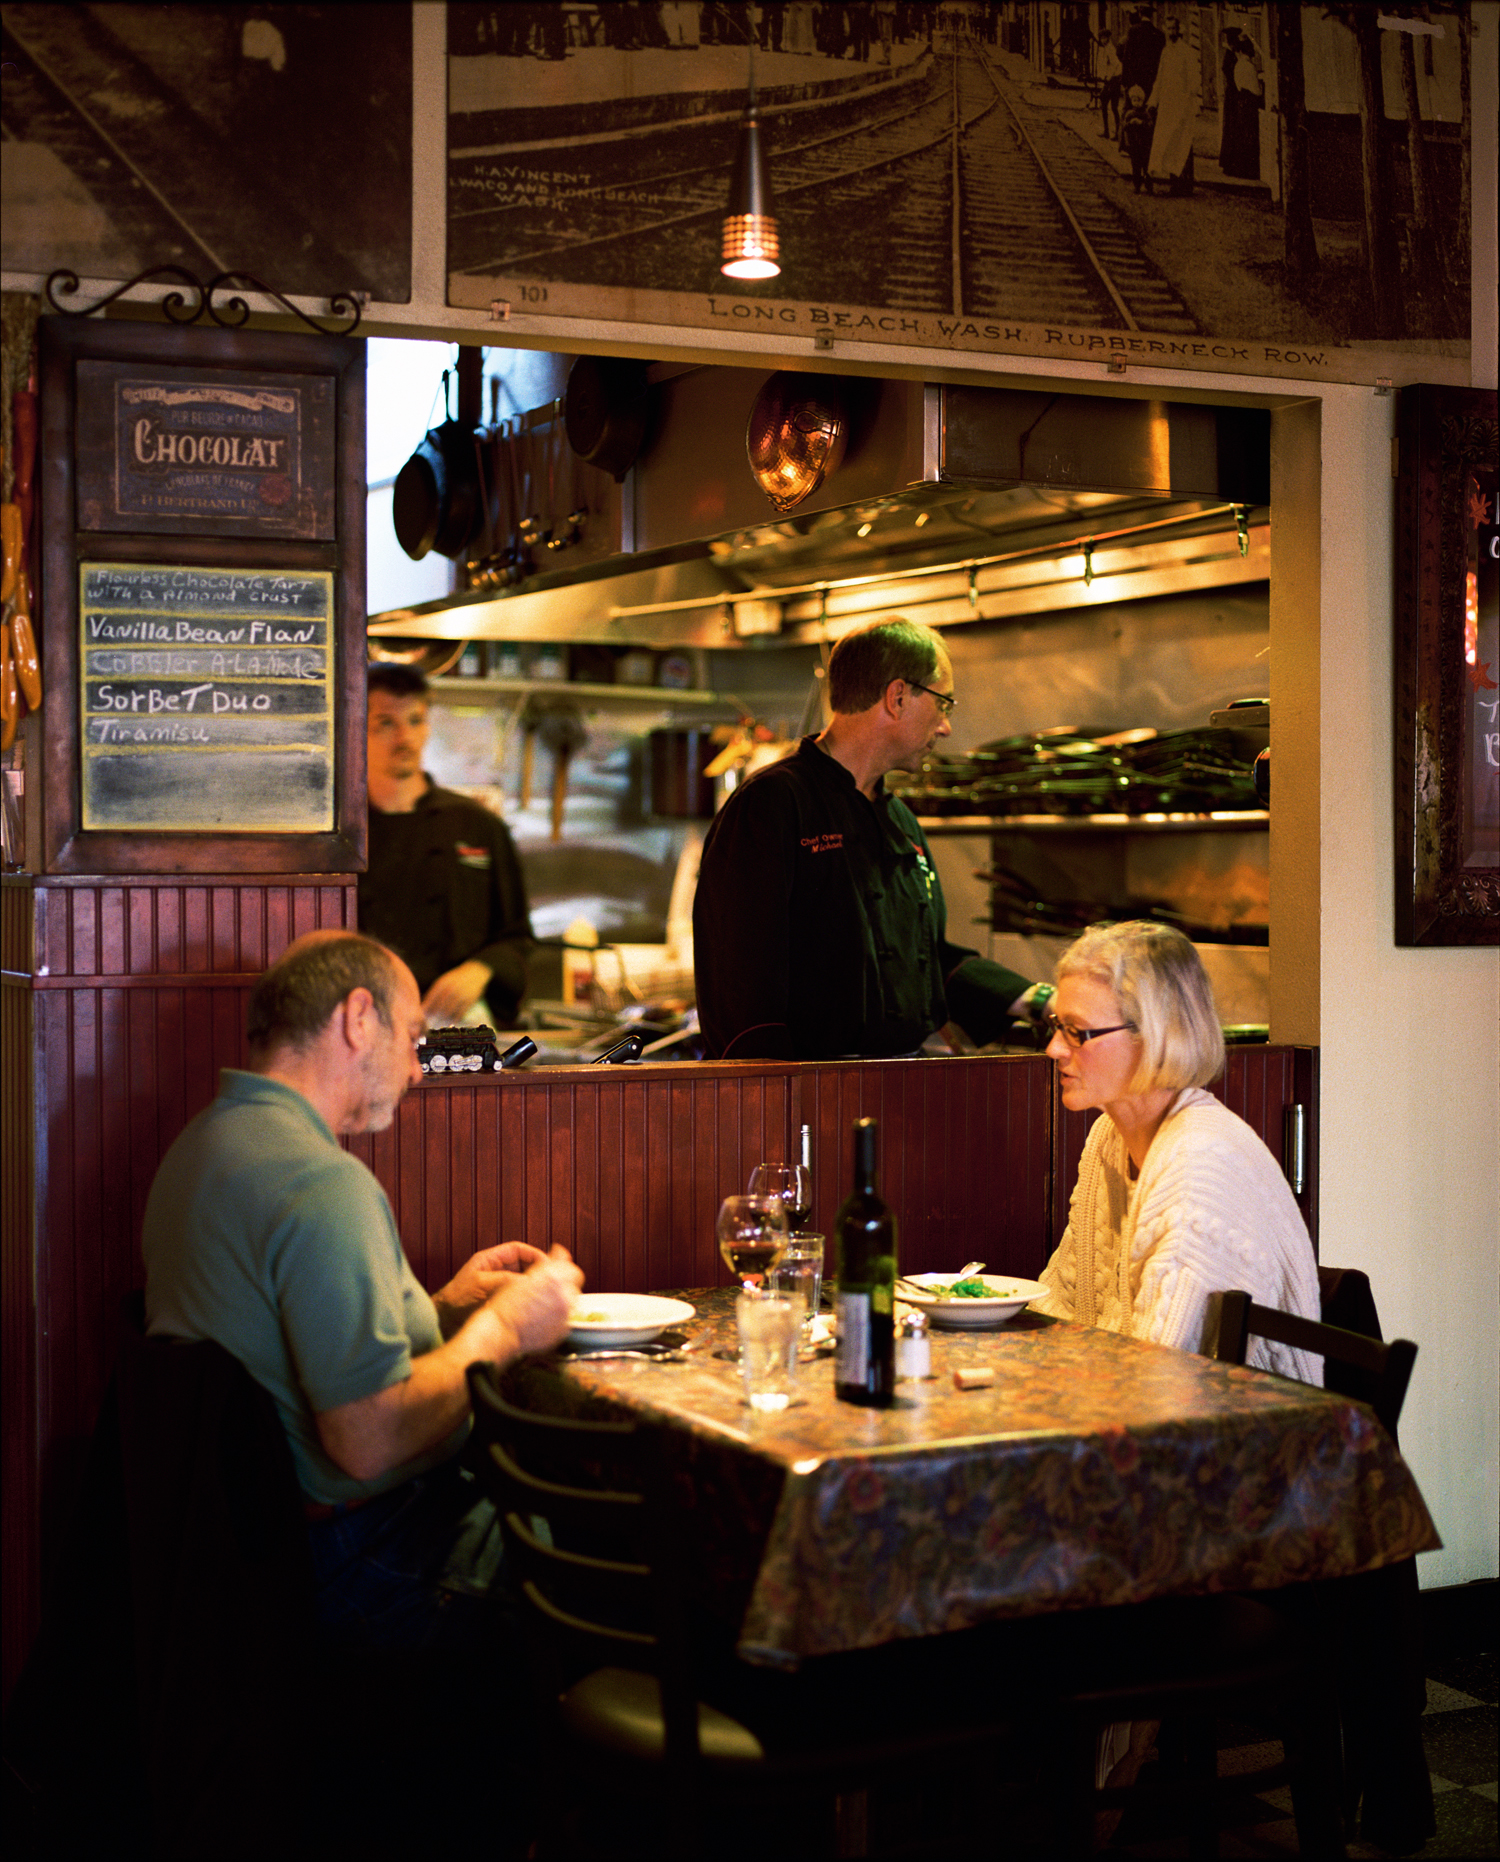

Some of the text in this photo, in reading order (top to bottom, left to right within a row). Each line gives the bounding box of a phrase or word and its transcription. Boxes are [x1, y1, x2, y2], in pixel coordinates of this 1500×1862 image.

[513, 182, 550, 196] AND
[707, 297, 797, 323] LONG
[937, 319, 1030, 343] WASH.
[1043, 328, 1250, 361] RUBBERNECK
[1263, 346, 1329, 367] ROW.
[133, 418, 285, 469] CHOCOLAT
[212, 690, 272, 714] Duo
[92, 718, 210, 744] Tiramisu
[800, 836, 819, 847] Chef
